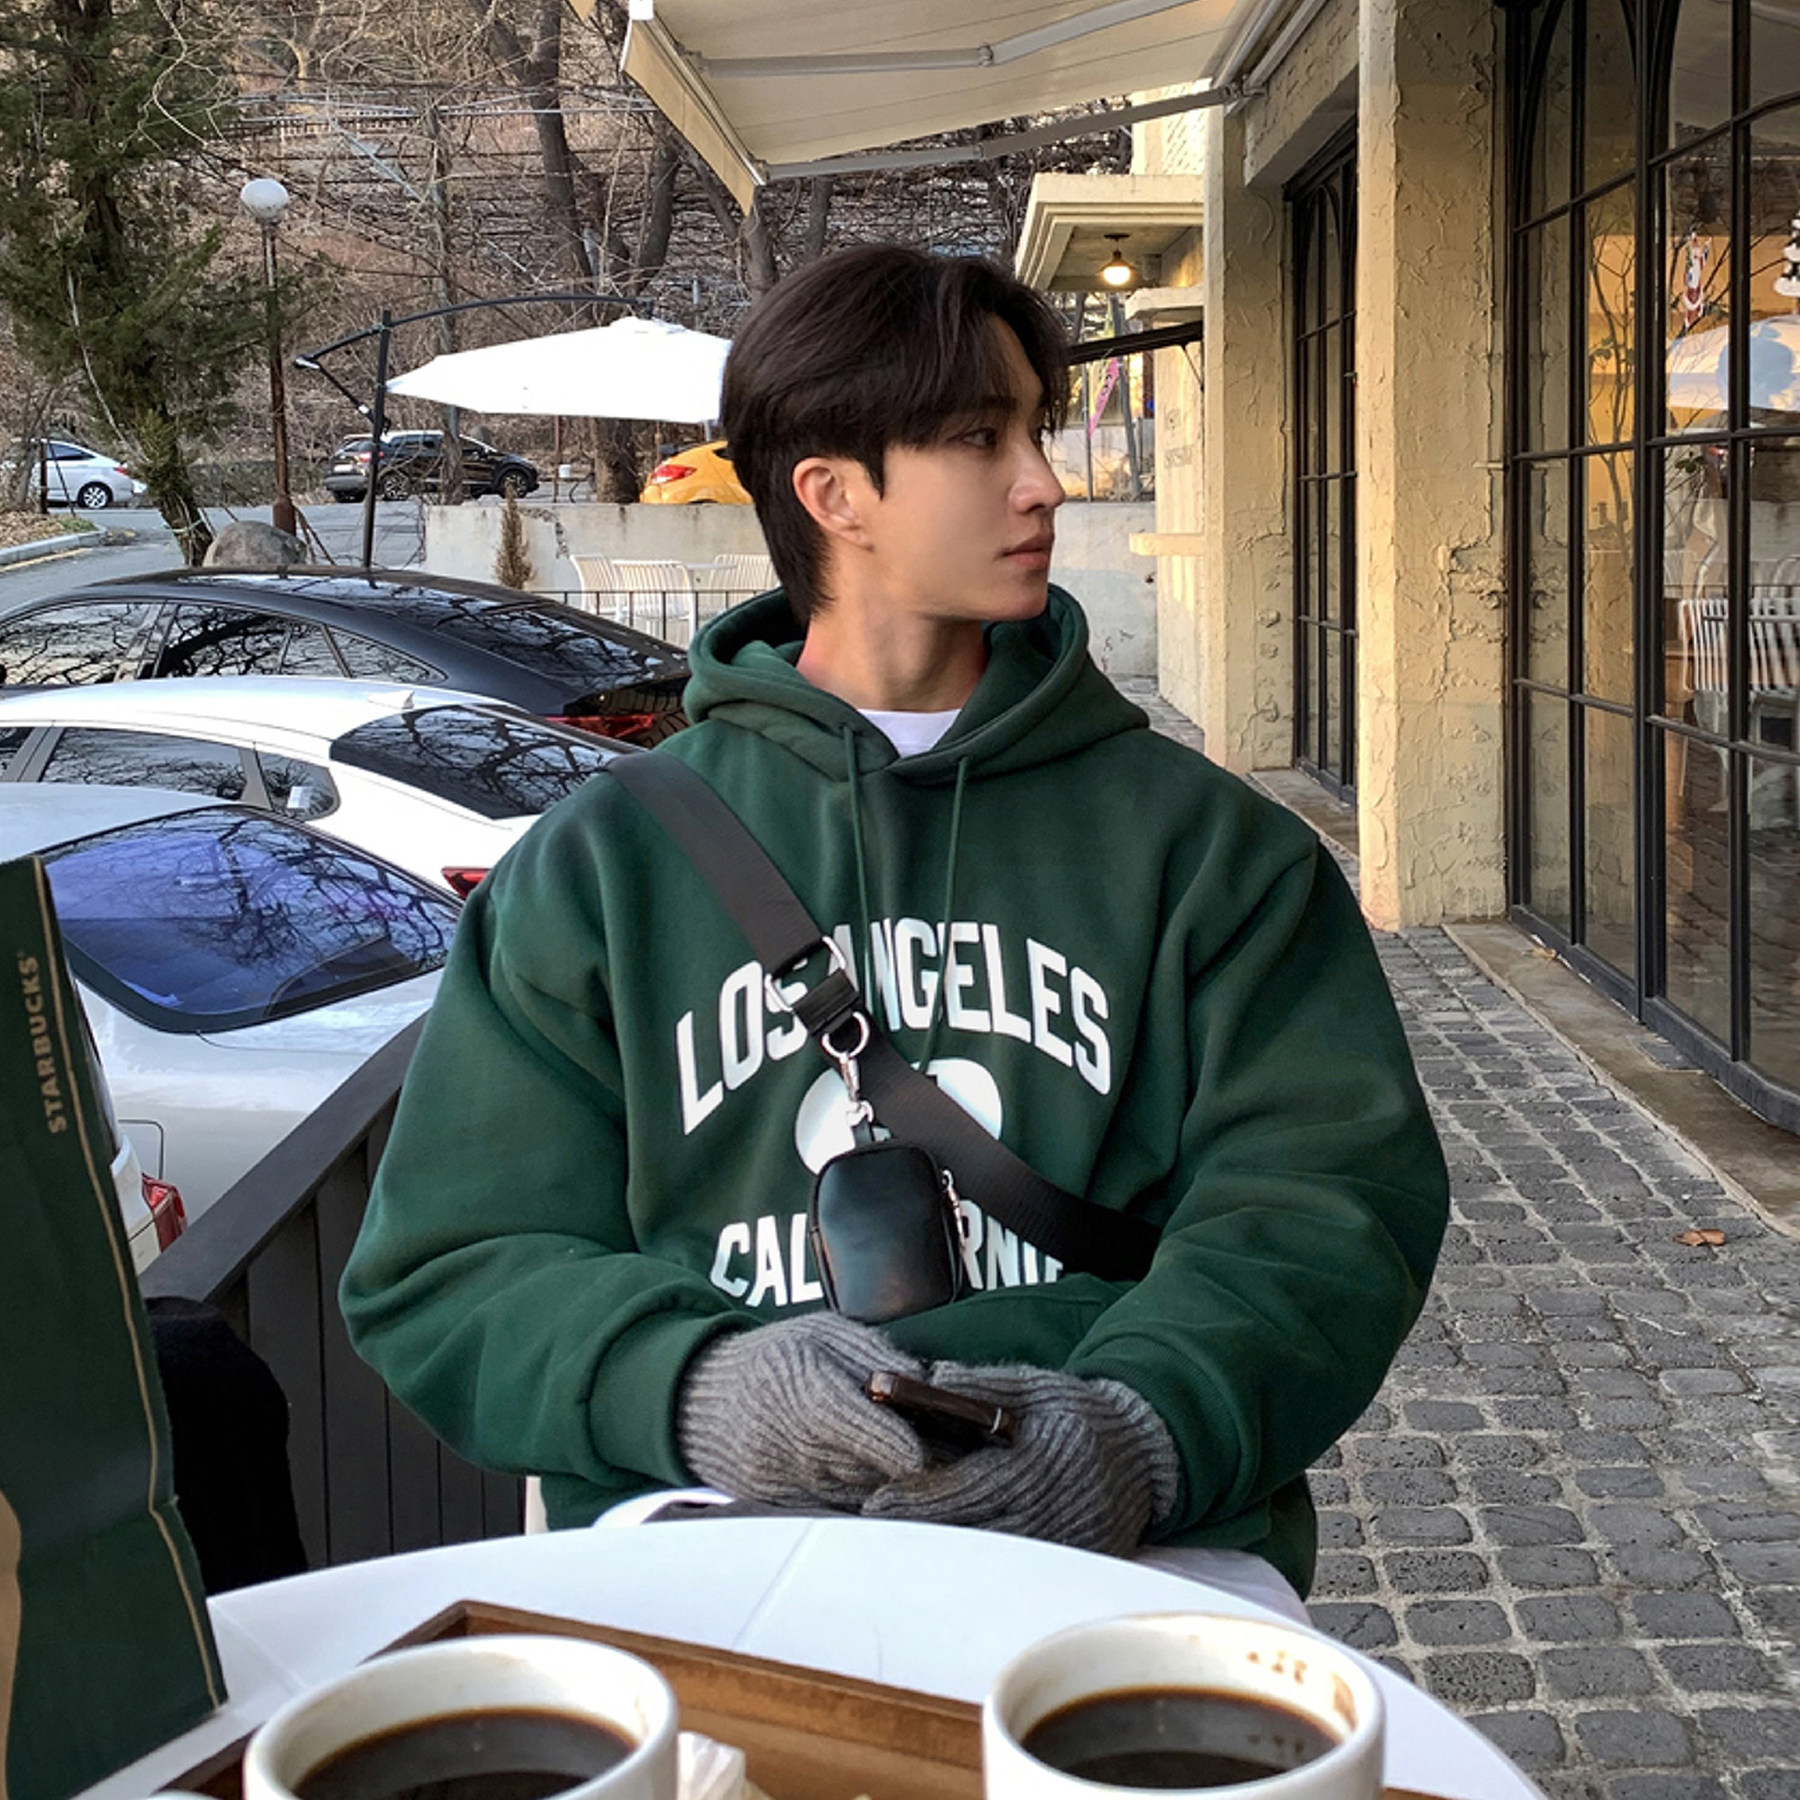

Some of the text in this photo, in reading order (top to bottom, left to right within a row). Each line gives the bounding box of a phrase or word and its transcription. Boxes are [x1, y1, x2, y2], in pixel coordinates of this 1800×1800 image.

[18, 956, 68, 1134] STARBUCKS
[675, 960, 808, 1135] LOS
[710, 1200, 1064, 1307] CALRNI
